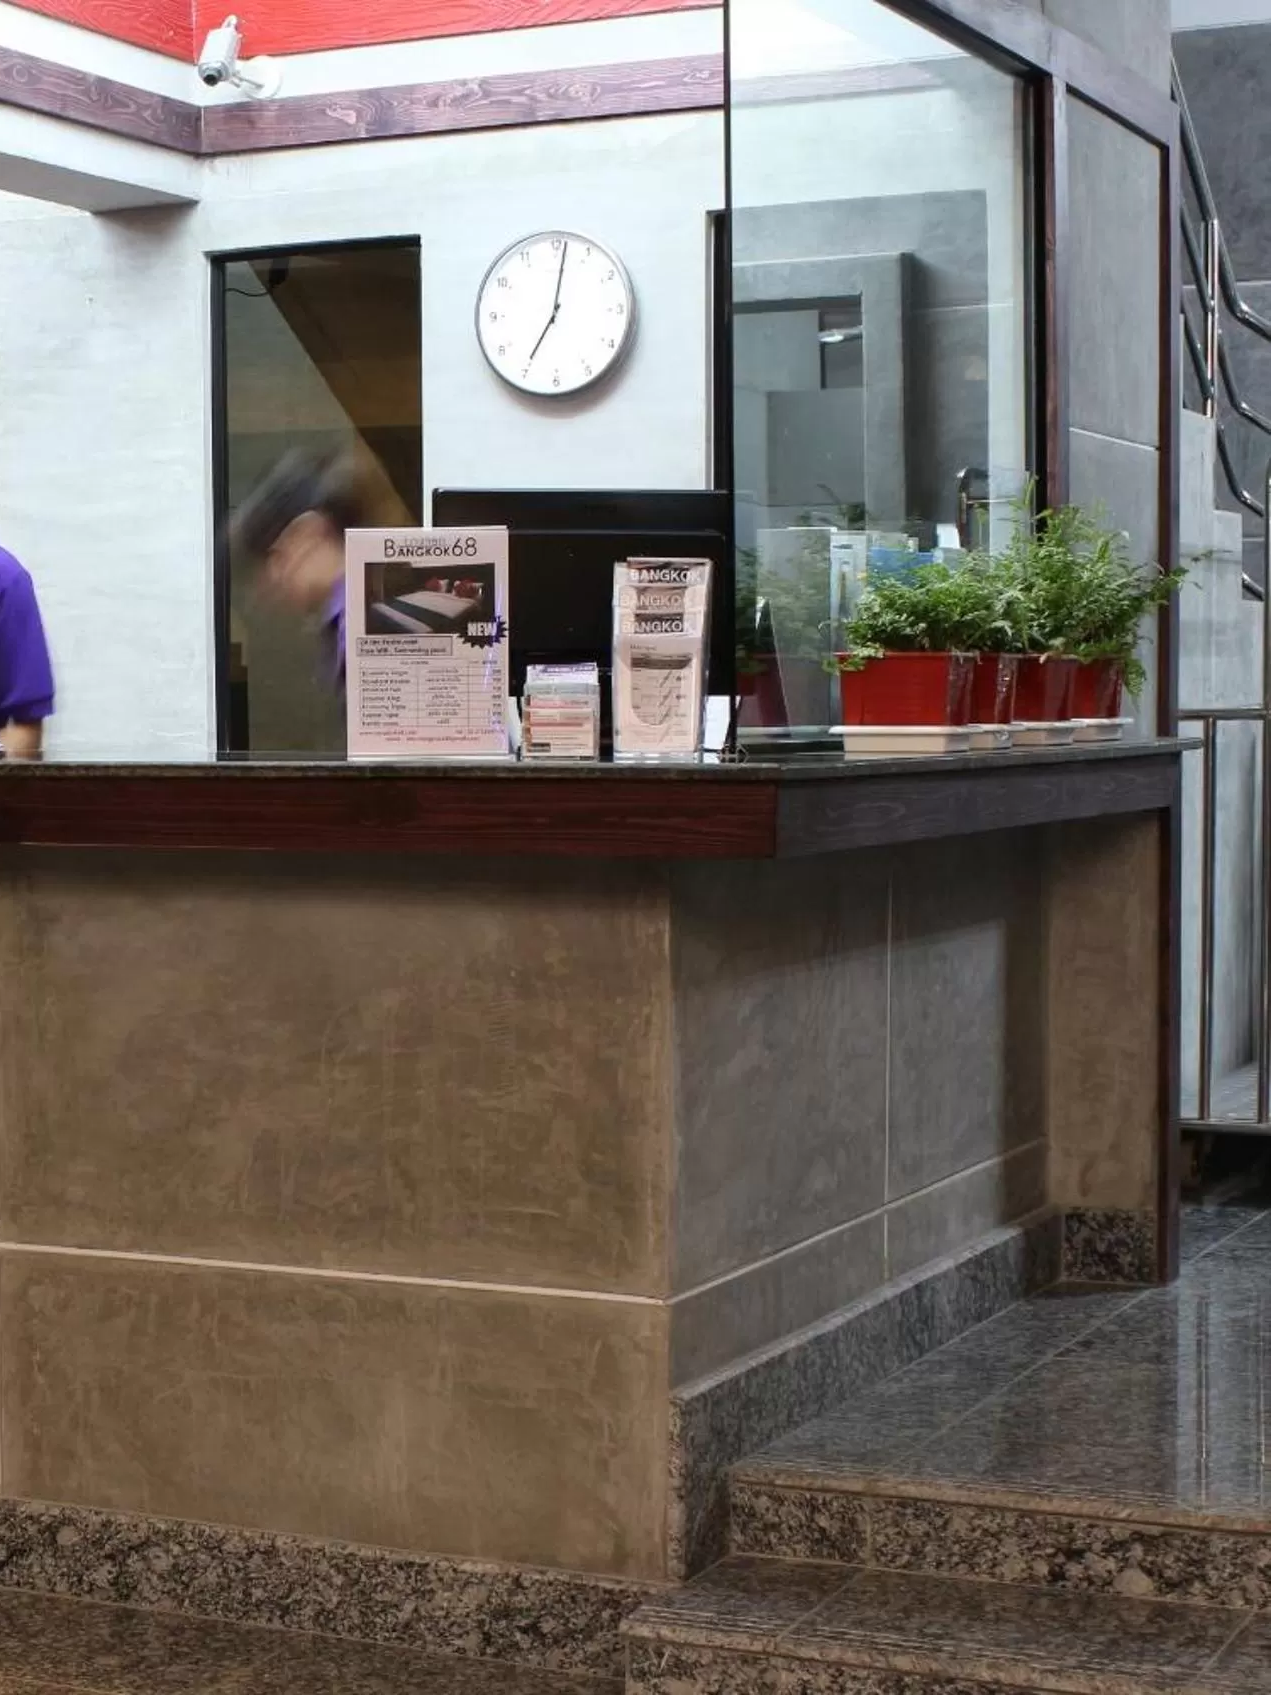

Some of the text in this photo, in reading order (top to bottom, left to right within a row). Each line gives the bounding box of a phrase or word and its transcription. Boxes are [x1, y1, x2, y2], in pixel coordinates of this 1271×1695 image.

[629, 568, 702, 582] BANGKOK
[620, 592, 691, 607] BANGKO
[467, 621, 498, 637] NEW
